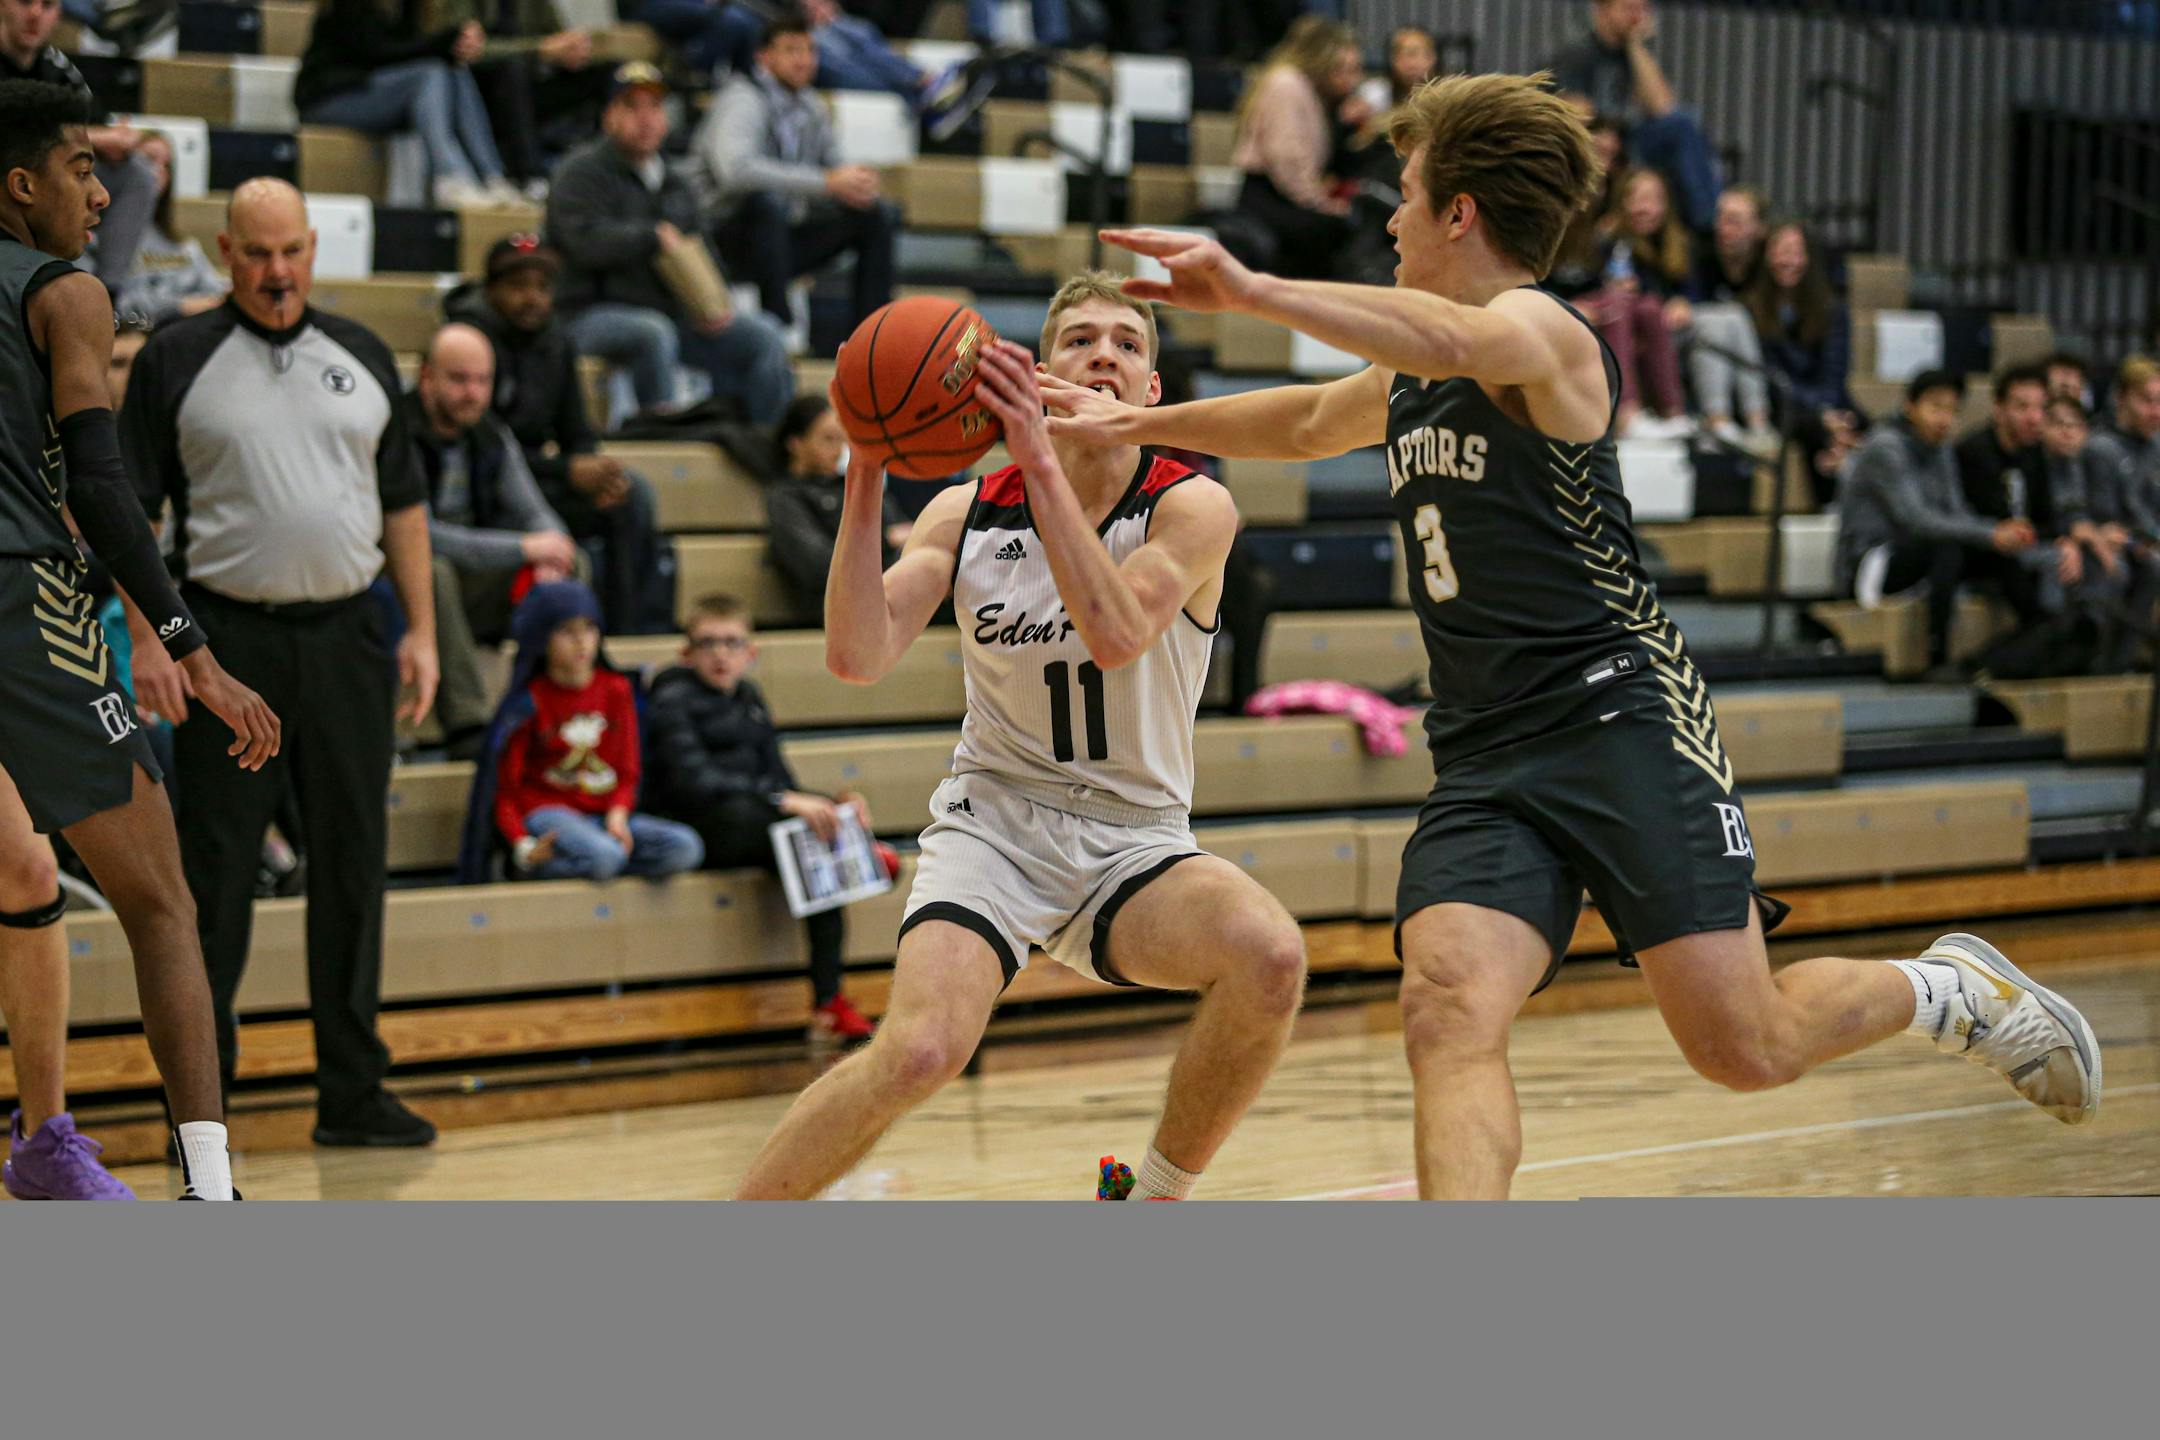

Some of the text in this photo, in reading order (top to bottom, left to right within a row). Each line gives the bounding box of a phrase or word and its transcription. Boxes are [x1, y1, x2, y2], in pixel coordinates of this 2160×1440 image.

[1414, 503, 1460, 604] 3
[974, 602, 1056, 646] Eden
[1617, 658, 1630, 669] M
[1043, 660, 1108, 763] 11
